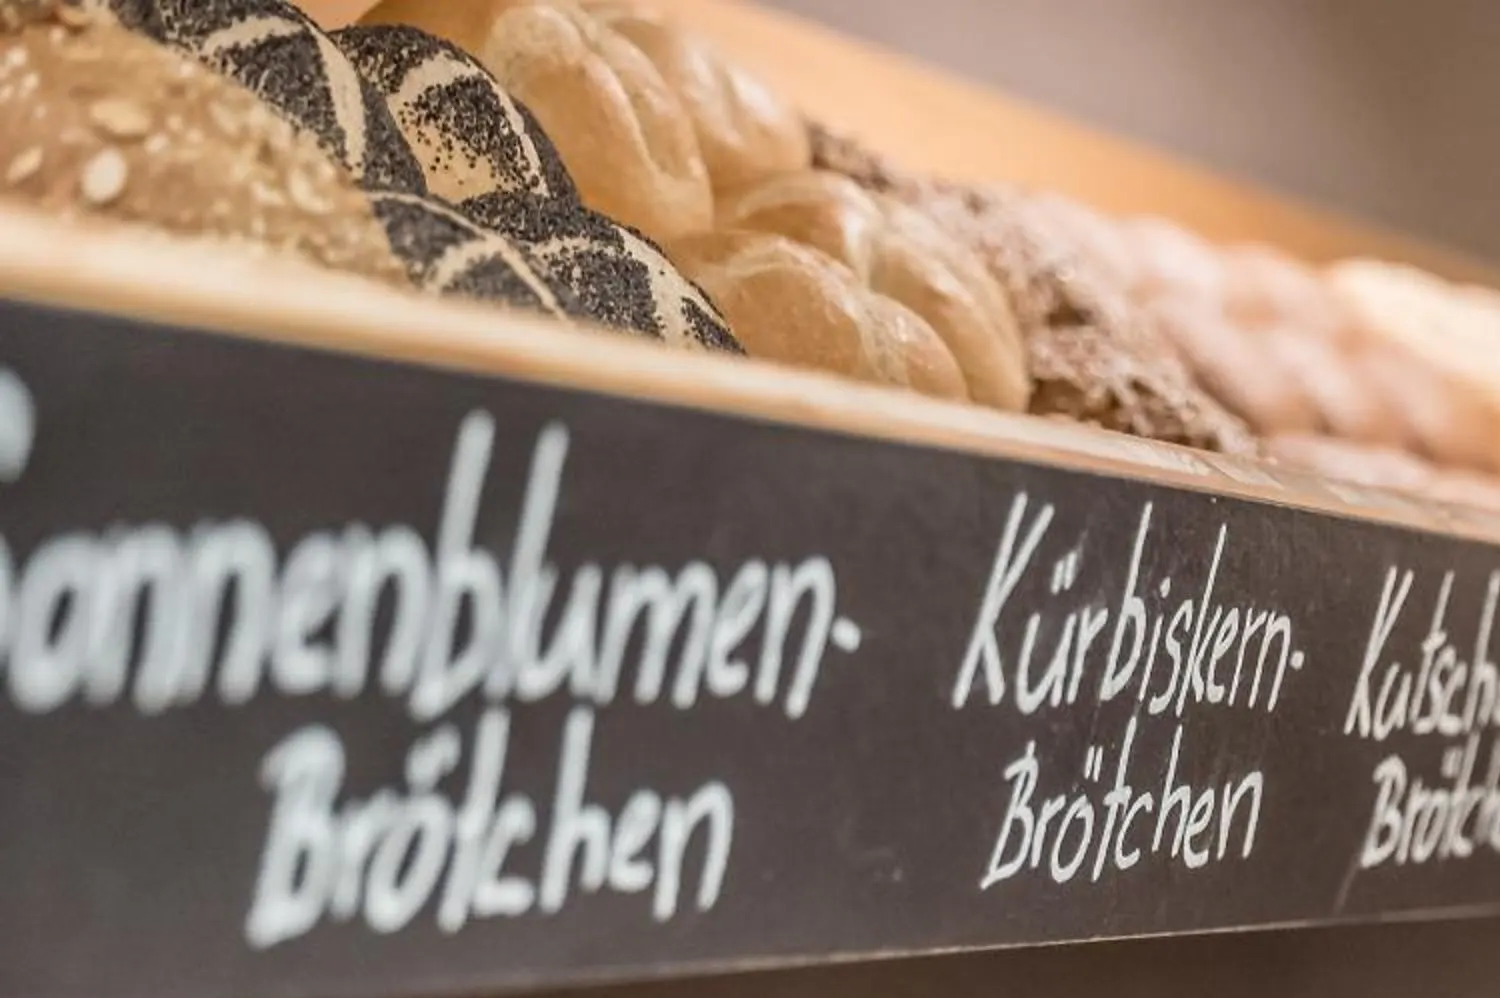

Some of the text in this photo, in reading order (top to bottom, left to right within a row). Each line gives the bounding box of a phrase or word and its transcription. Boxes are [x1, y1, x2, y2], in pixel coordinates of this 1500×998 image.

[952, 490, 1305, 718] Kürbiskern-
[245, 706, 734, 948] Brötchen
[980, 715, 1264, 890] Brötchen
